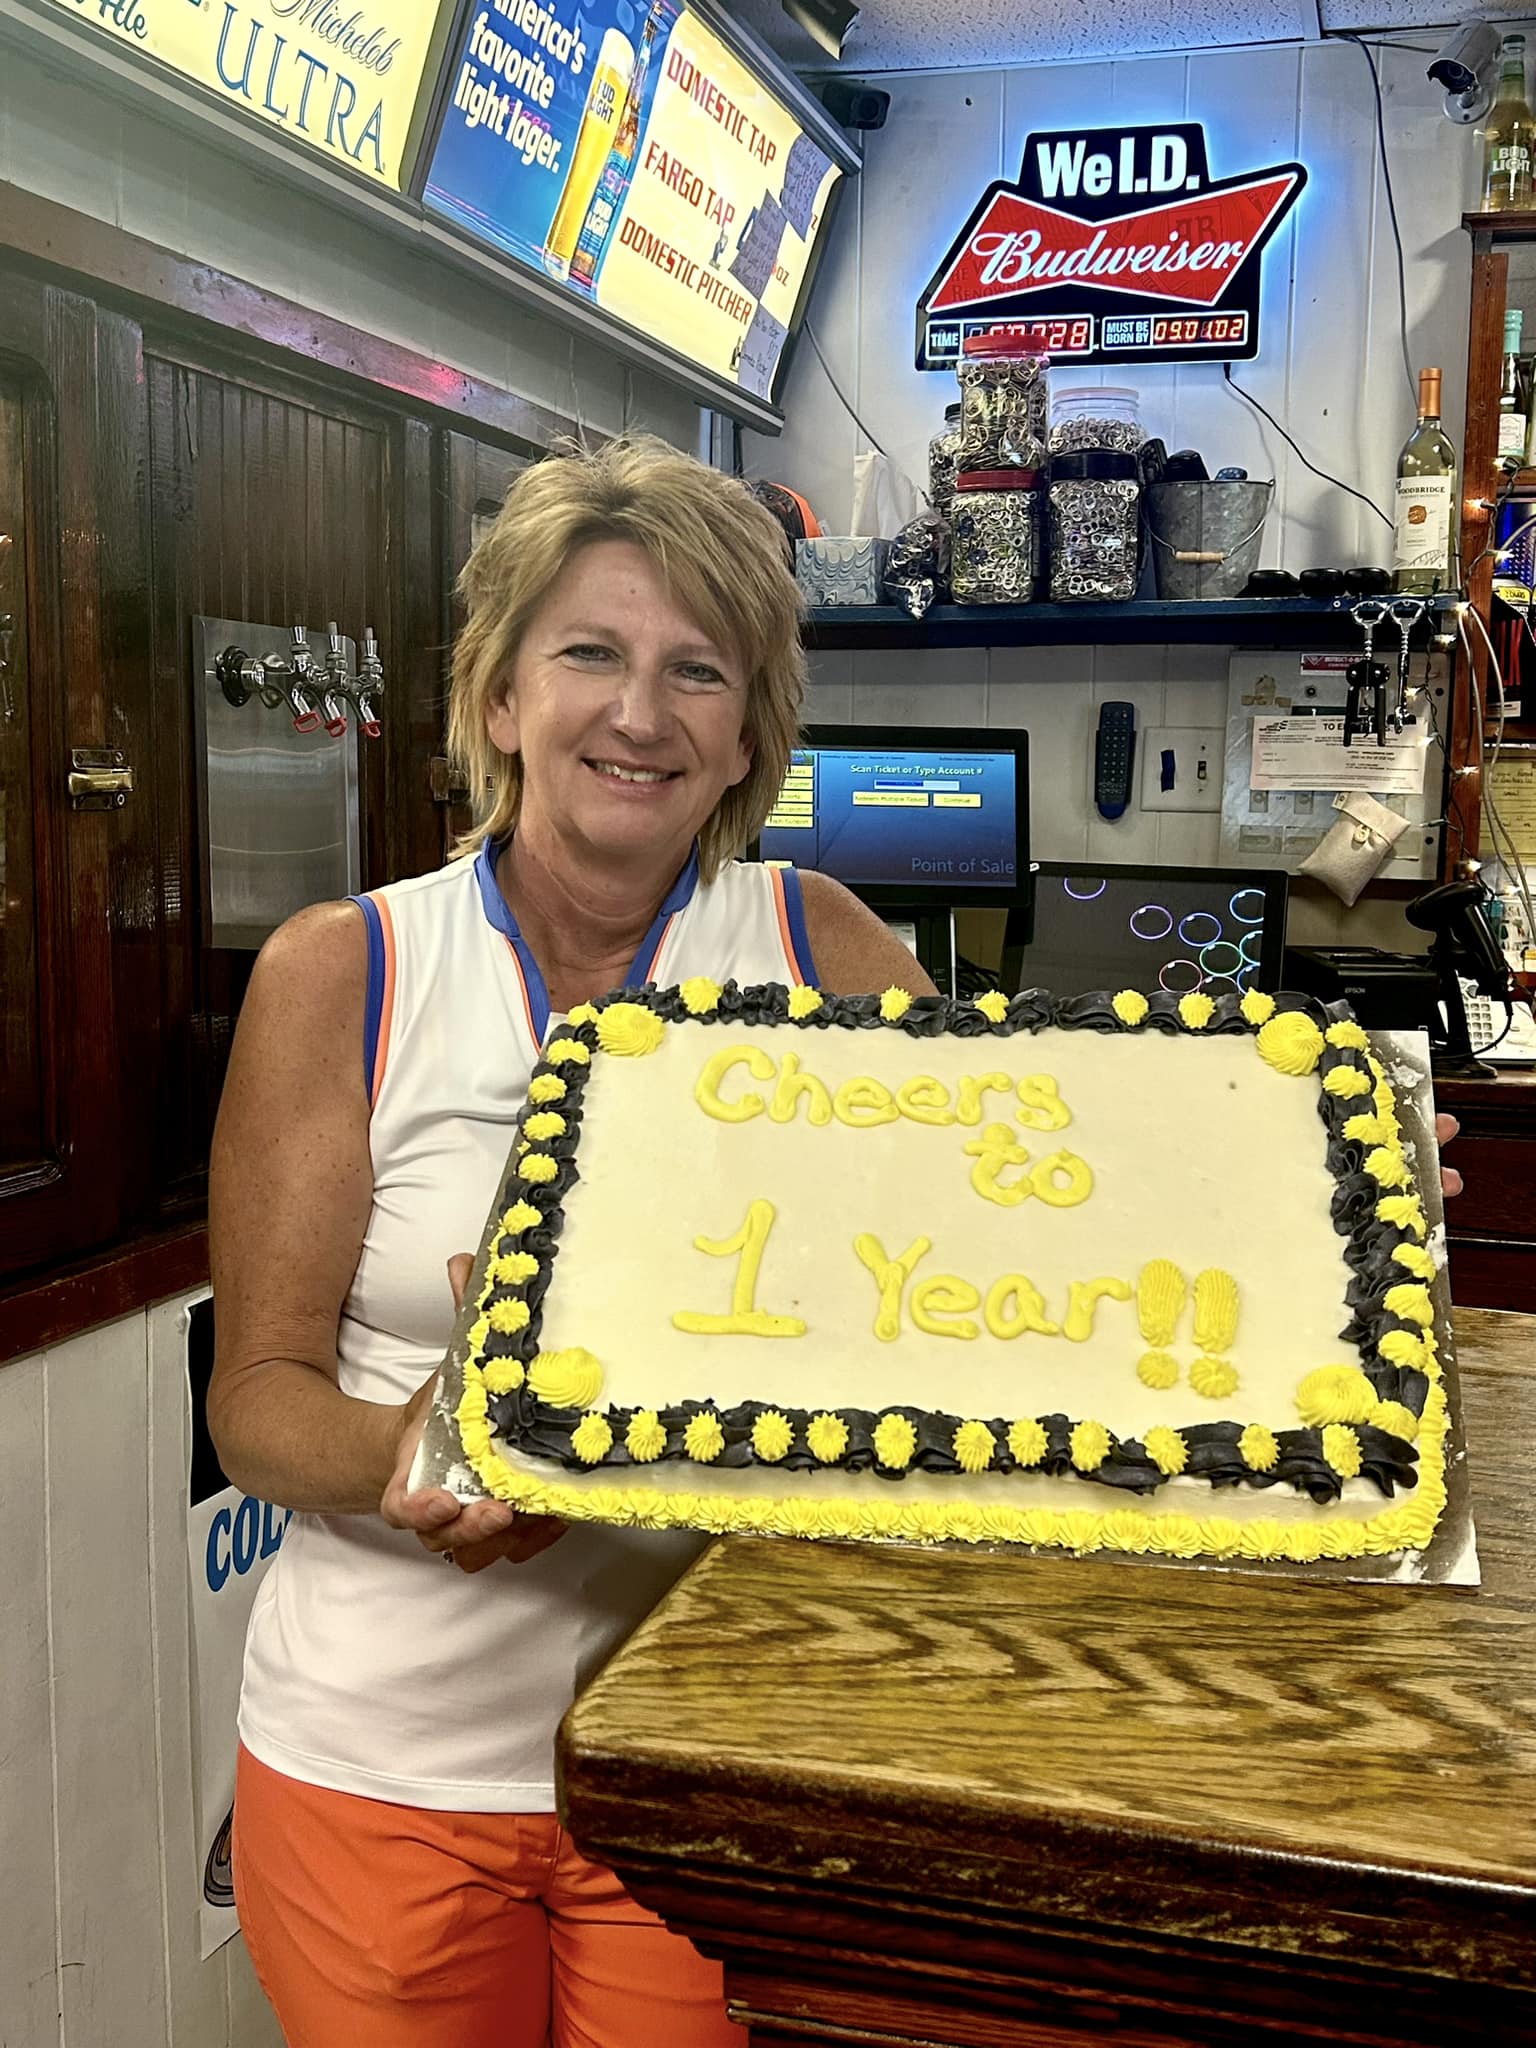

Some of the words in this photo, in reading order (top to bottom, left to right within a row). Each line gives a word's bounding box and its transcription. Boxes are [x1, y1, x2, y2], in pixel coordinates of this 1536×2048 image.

[469, 11, 555, 109] favorite
[486, 0, 587, 74] merica's
[216, 2, 385, 175] ULTRA
[453, 61, 510, 136] light
[505, 99, 562, 174] lager.
[667, 48, 749, 145] DOMESTIC
[748, 123, 776, 167] TAP
[644, 140, 704, 207] FARGO
[704, 187, 735, 228] TAP
[1492, 159, 1530, 172] LIGHT
[1499, 146, 1528, 159] BUD
[619, 217, 699, 290] DOMESTIC
[696, 269, 752, 326] PITCHER
[971, 229, 1243, 284] Budweiser
[931, 331, 959, 347] TIME
[1106, 322, 1134, 333] MUST
[1136, 320, 1149, 332] BE
[1106, 333, 1134, 344] BORN
[1136, 332, 1149, 343] BY
[1323, 723, 1336, 731] TO
[850, 764, 872, 773] Scan
[874, 765, 901, 774] Ticket
[914, 766, 936, 776] Type
[937, 767, 975, 775] Account
[911, 857, 953, 873] Point
[959, 857, 977, 873] of
[981, 858, 1014, 874] Sale
[696, 1044, 1072, 1131] Cheers
[963, 1122, 1094, 1207] to
[672, 1199, 806, 1337] 1
[206, 1495, 294, 1592] COL
